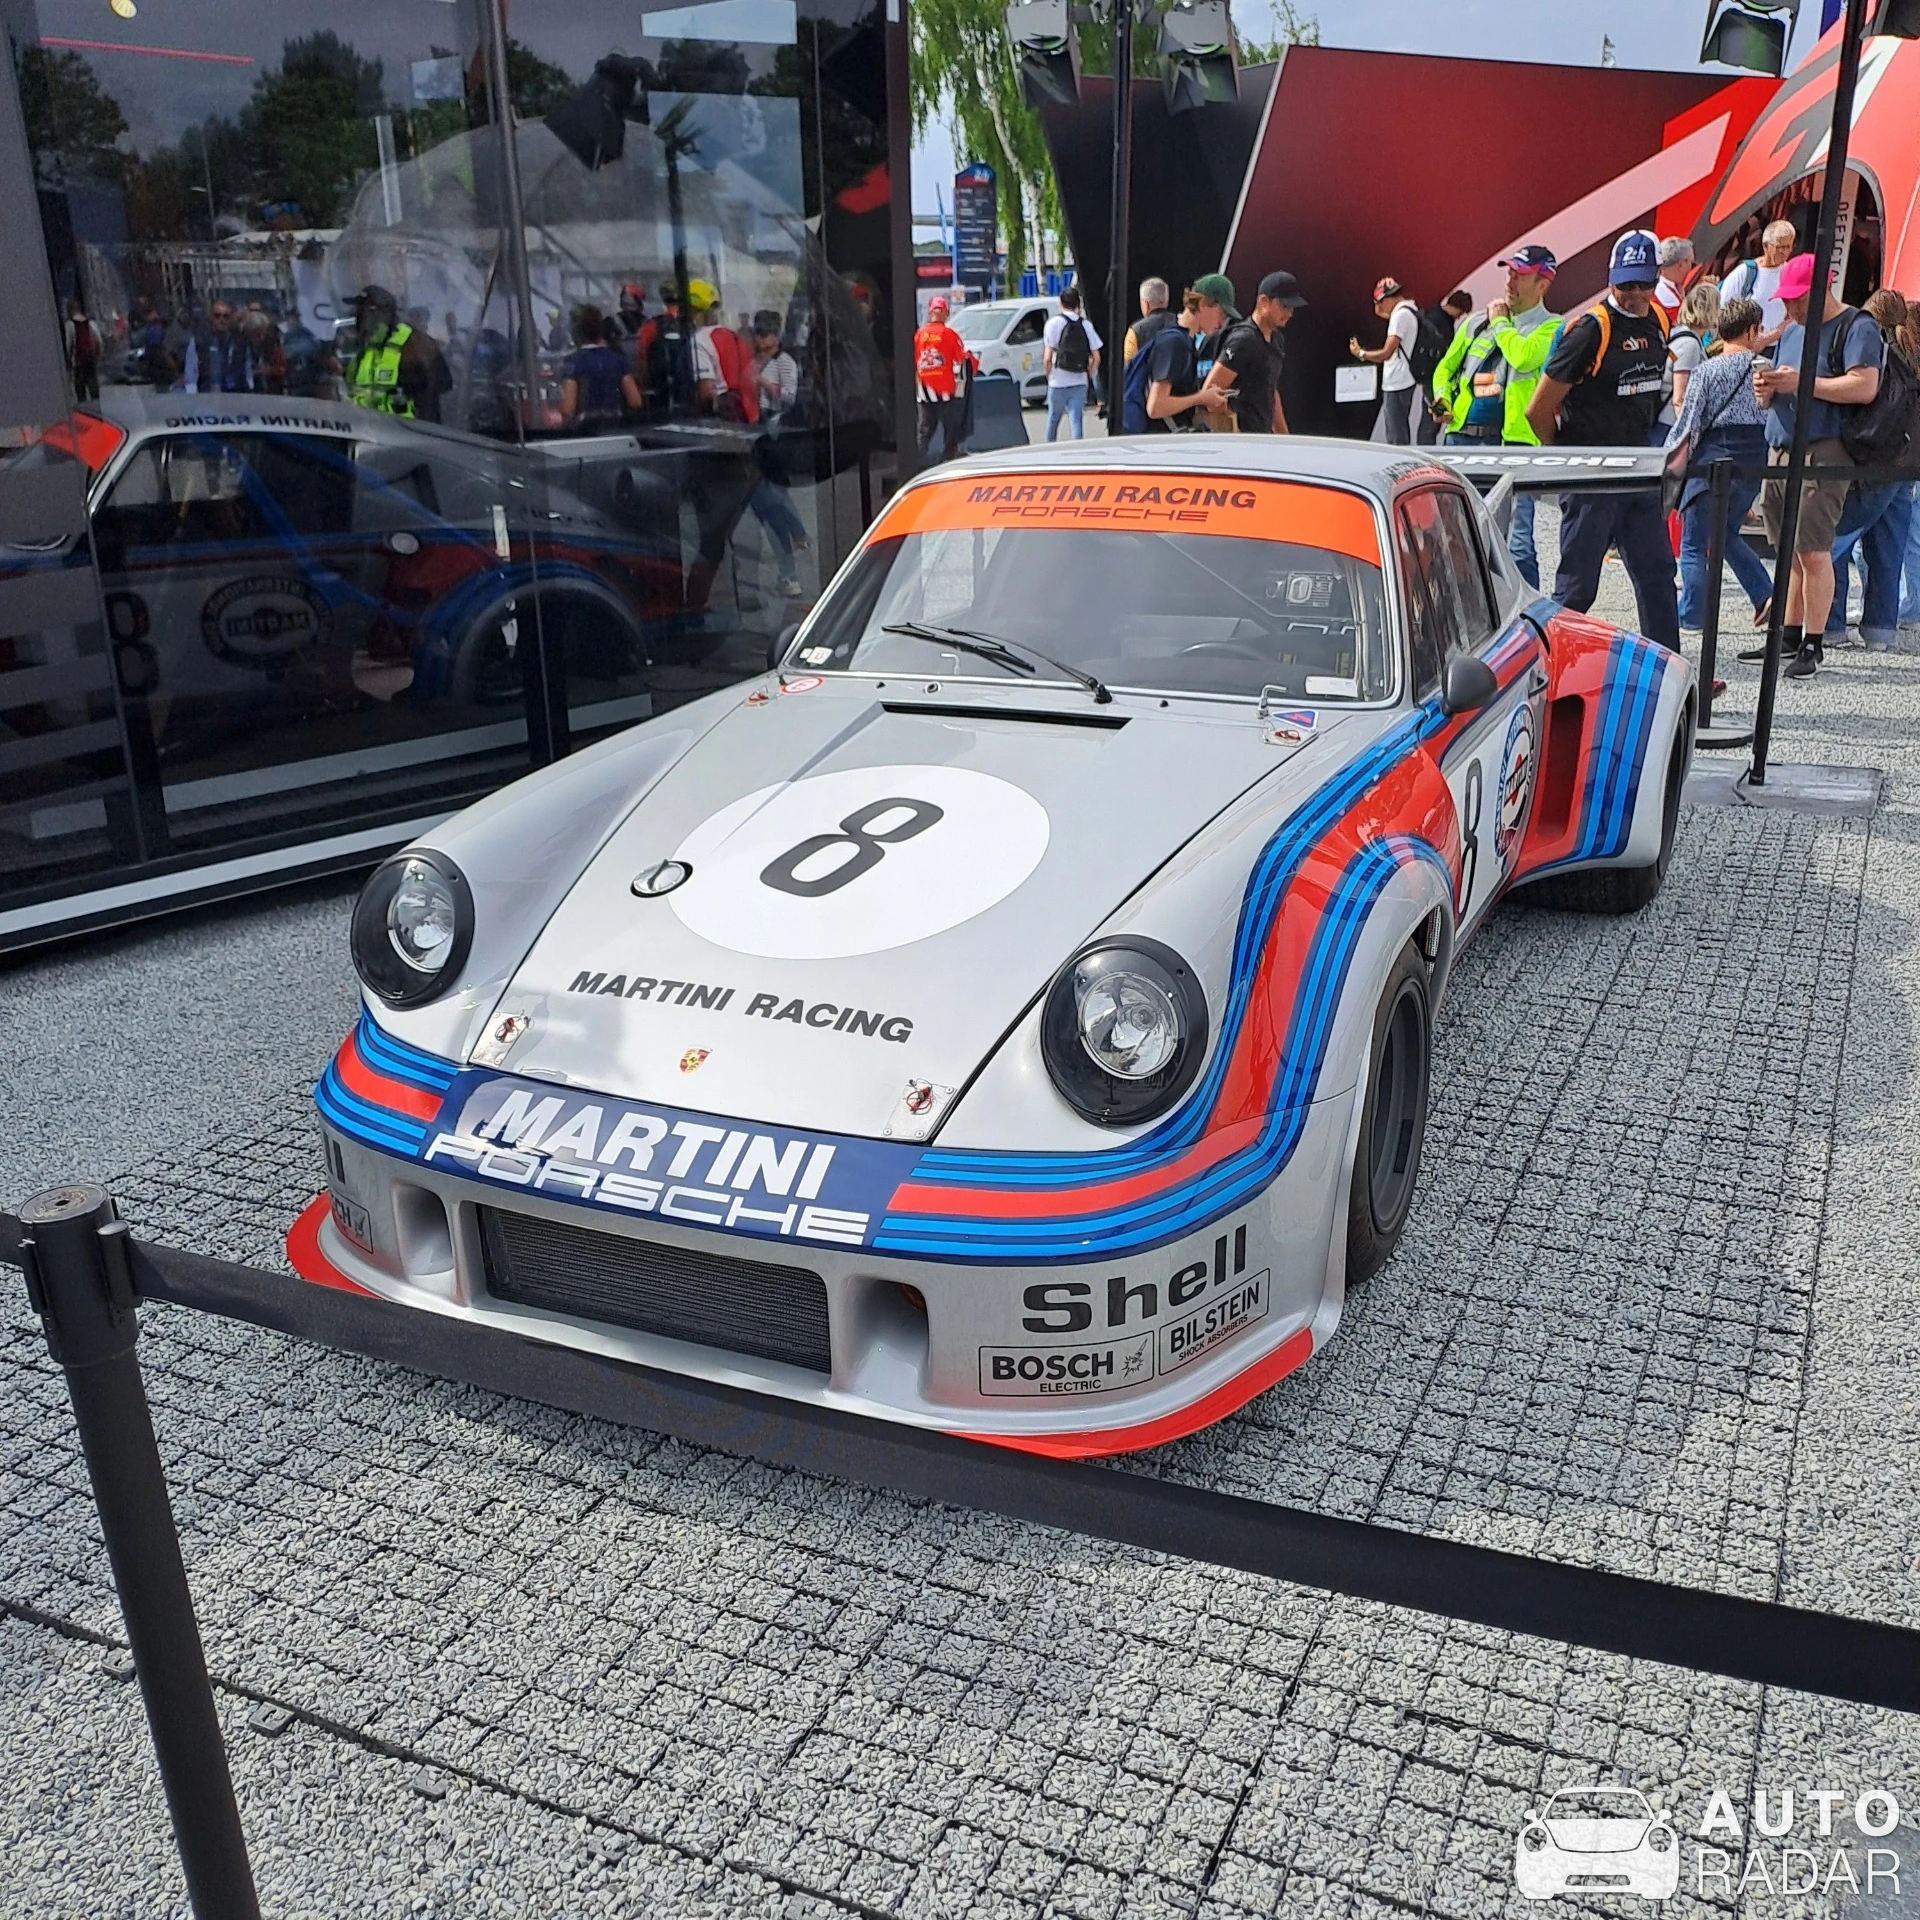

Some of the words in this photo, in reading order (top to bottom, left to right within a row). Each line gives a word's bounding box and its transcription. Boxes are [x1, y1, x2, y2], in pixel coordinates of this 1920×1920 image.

[1440, 455, 1637, 467] ORSCHE
[966, 485, 1107, 504] MARTINI
[1113, 486, 1257, 509] RACING
[991, 506, 1209, 522] PORSCHE
[759, 796, 945, 898] 8
[567, 970, 736, 1012] MARTINI
[744, 992, 914, 1044] RACING
[480, 1089, 837, 1200] MARTINI
[424, 1131, 870, 1246] PORSCHE
[1022, 1223, 1247, 1334] Shell
[1170, 1281, 1260, 1354] BILSTEIN
[1178, 1341, 1205, 1361] SHOCK
[1207, 1313, 1248, 1346] ABSORBERS
[992, 1350, 1114, 1380] BOSCH
[1040, 1379, 1102, 1393] ELECTRIC
